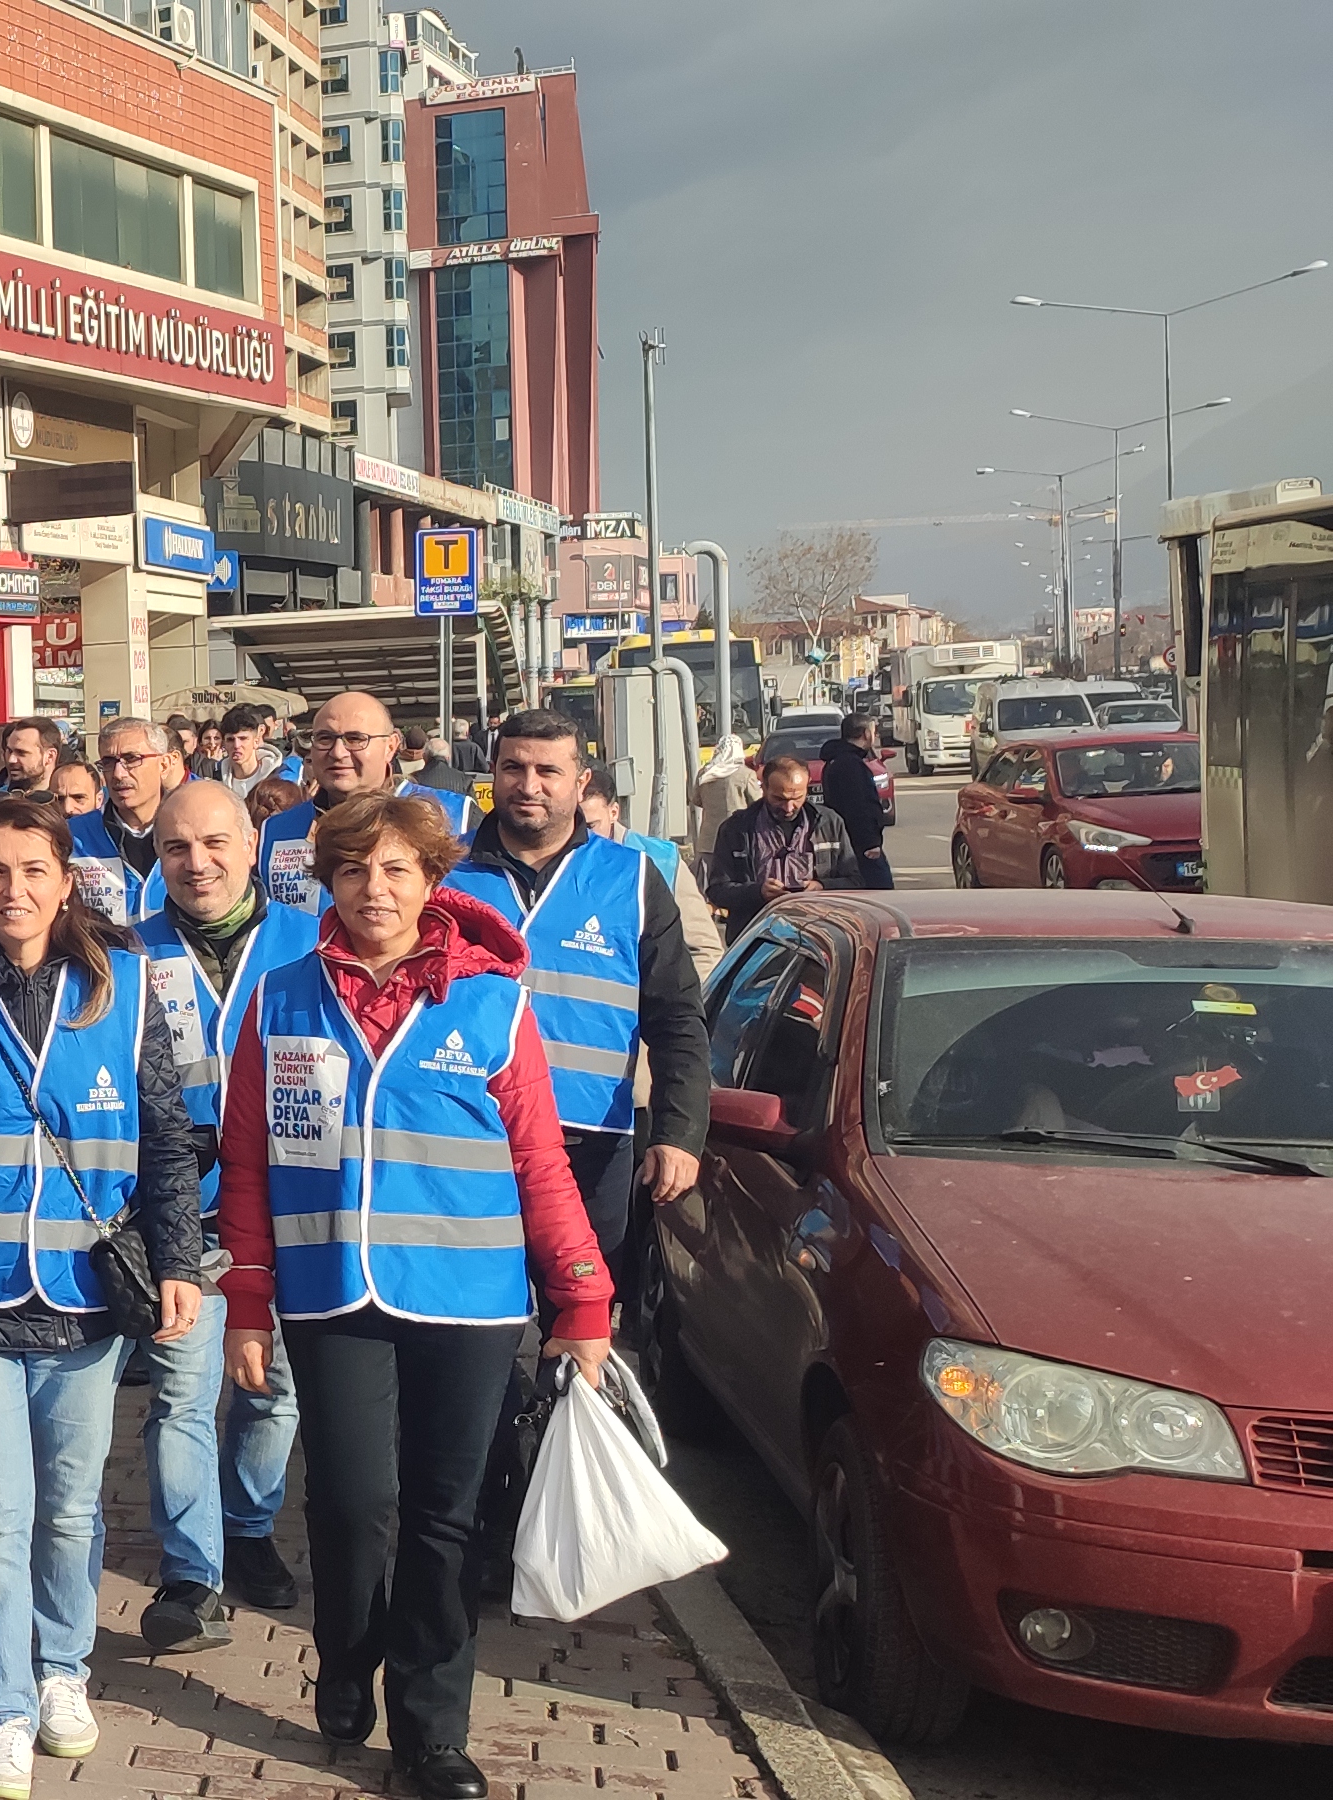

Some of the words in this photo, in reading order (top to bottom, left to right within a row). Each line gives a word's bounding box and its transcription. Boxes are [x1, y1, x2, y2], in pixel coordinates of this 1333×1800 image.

[410, 48, 420, 60] E
[65, 285, 146, 356] EĞİTİM
[147, 308, 274, 384] MÜDÜRLÜĞÜ
[586, 519, 631, 539] İMZA
[434, 539, 459, 570] T
[575, 930, 605, 943] DEVA
[273, 1050, 326, 1064] KAZANAN
[435, 1047, 473, 1063] DEVA
[273, 1074, 307, 1087] OLSUN
[88, 1087, 118, 1098] DEVA
[272, 1087, 322, 1106] OYLAR
[273, 1104, 311, 1122] DEVA
[271, 1122, 322, 1140] OLSUN
